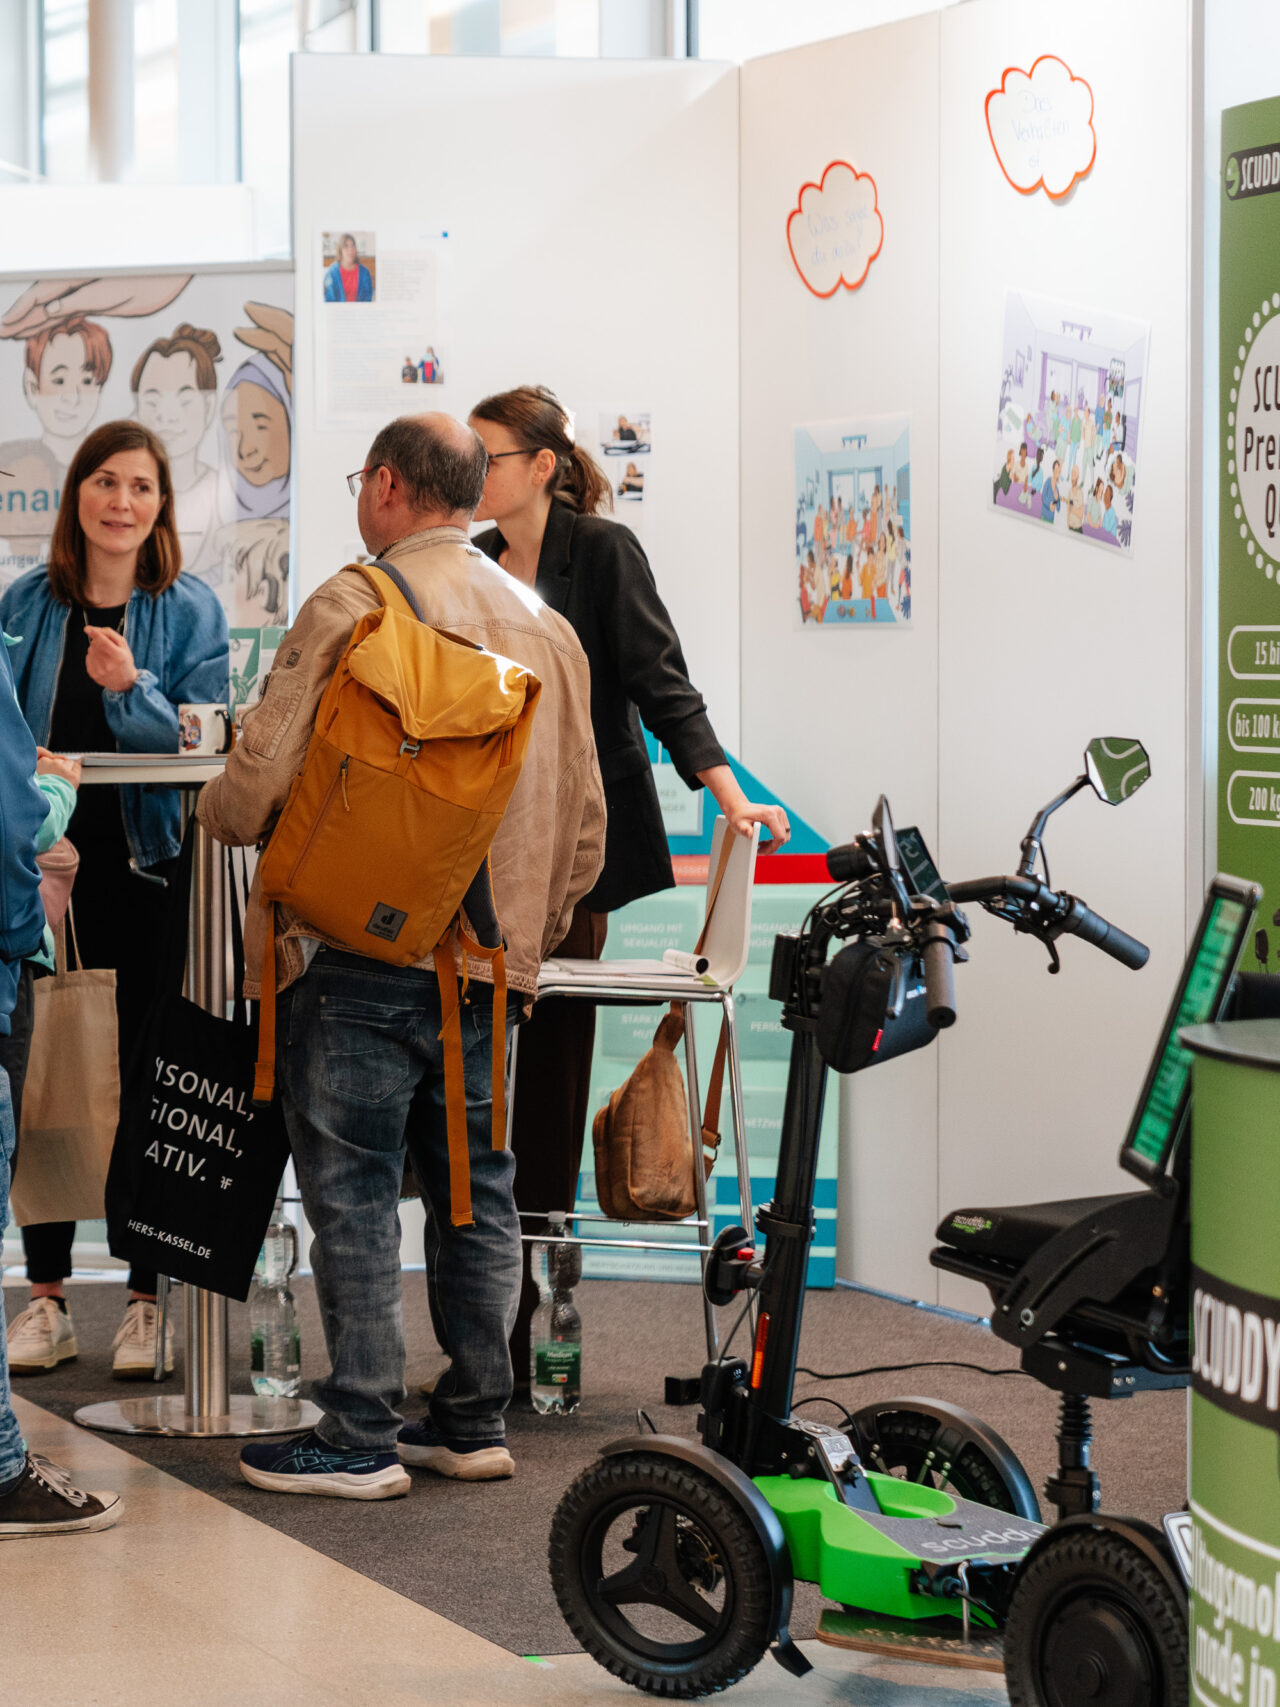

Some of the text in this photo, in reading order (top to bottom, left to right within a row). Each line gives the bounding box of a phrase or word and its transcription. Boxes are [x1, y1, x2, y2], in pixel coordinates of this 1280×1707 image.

[1242, 426, 1280, 472] Pre
[1255, 641, 1267, 665] 15
[1235, 711, 1250, 738] bis
[1251, 714, 1270, 739] 100
[1249, 786, 1268, 812] 200
[750, 1021, 786, 1033] PERSO
[151, 1095, 243, 1159] IONAL,
[144, 1140, 207, 1183] ATIV.
[127, 1218, 212, 1260] HERS-KASSEL.DE
[1196, 1624, 1276, 1707] made in
